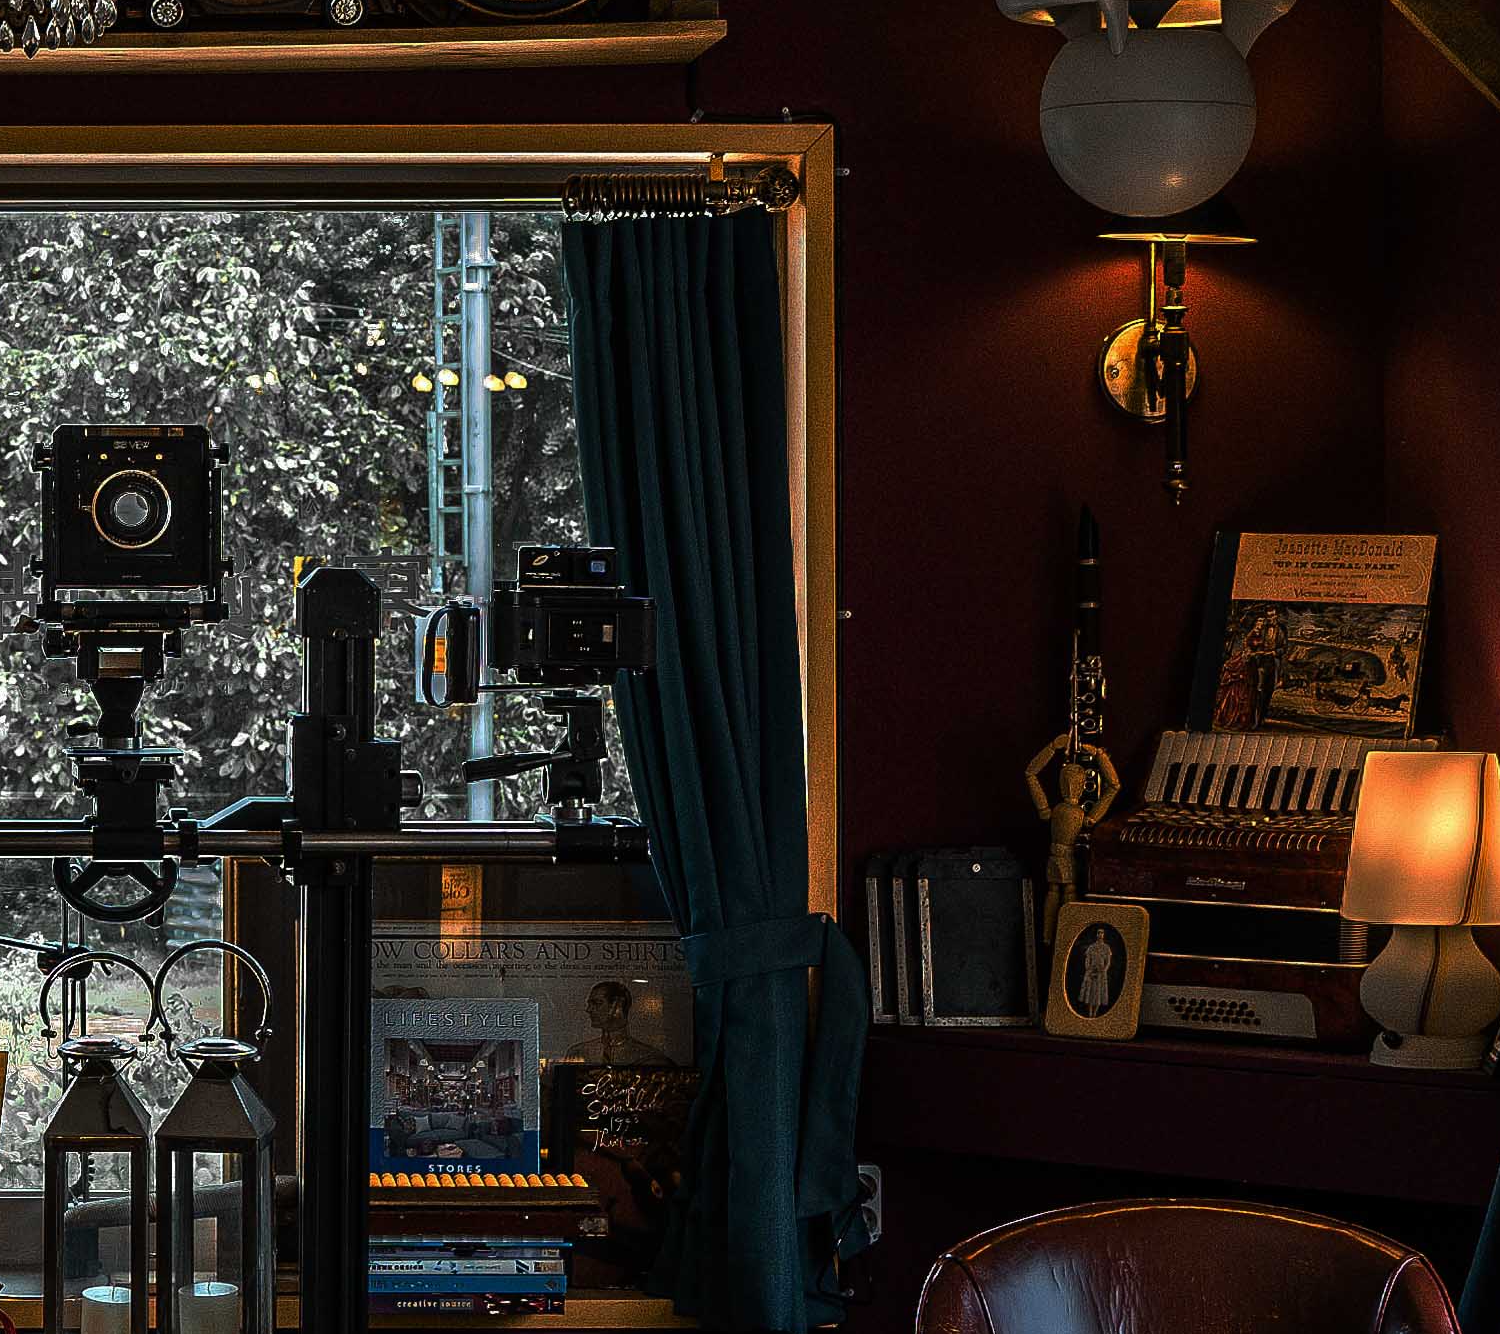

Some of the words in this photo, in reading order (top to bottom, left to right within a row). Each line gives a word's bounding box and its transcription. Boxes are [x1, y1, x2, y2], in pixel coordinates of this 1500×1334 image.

[1274, 538, 1329, 556] Jeanette
[1332, 539, 1404, 558] MacDonald
[413, 940, 526, 960] COLLARS
[535, 941, 592, 960] AND
[601, 942, 687, 962] SHIRTS
[384, 1012, 525, 1028] LIFESTYLE
[428, 1163, 483, 1173] STORES
[396, 1298, 439, 1308] creative
[440, 1299, 472, 1309] source
